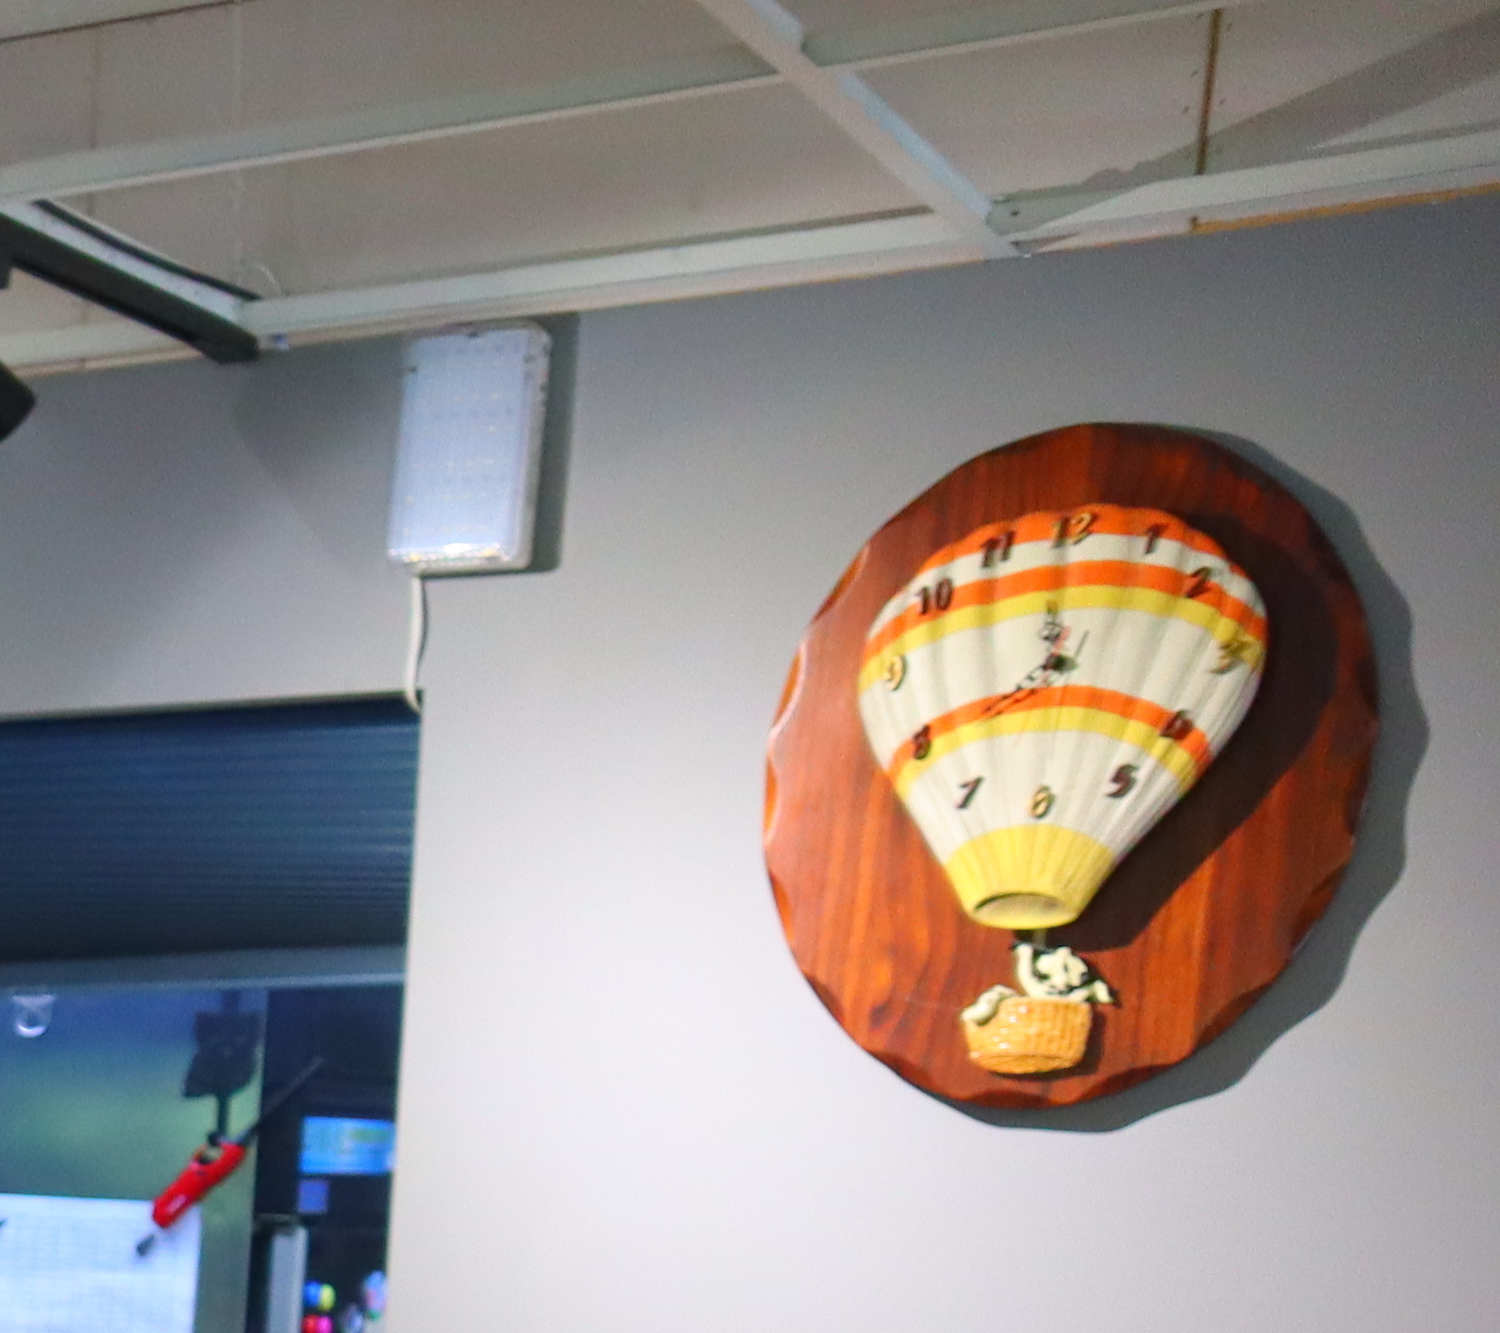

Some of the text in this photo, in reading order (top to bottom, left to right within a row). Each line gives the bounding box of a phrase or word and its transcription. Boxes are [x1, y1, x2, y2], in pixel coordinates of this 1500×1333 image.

[1052, 511, 1097, 548] 12
[1143, 524, 1167, 555] 1
[980, 530, 1014, 569] 11
[917, 576, 954, 614] 10
[1185, 565, 1214, 600] 2
[883, 657, 906, 692] 9
[955, 776, 983, 810] 7
[1106, 763, 1139, 800] 5
[1030, 785, 1056, 819] 6
